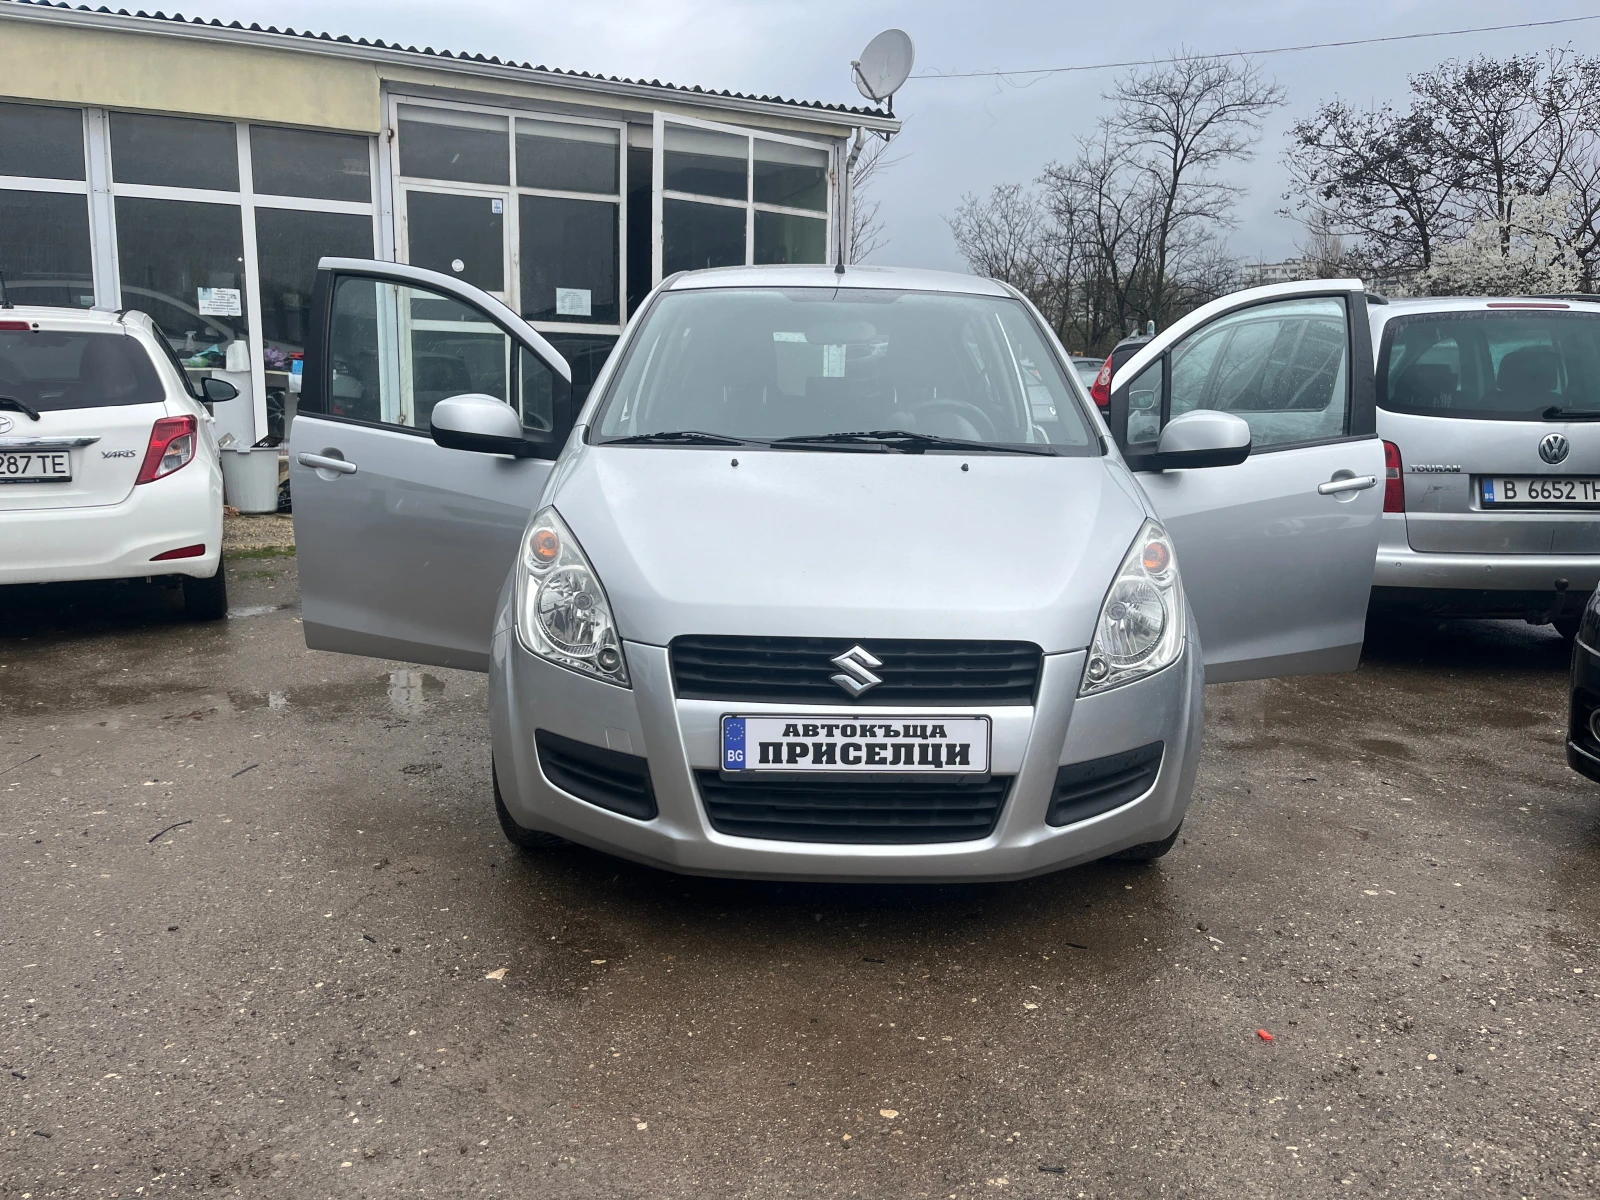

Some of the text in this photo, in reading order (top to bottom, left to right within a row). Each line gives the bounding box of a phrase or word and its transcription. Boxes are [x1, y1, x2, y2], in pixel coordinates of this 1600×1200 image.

[101, 450, 136, 459] YARIS
[37, 455, 66, 473] TE
[1409, 464, 1461, 473] TOURAN
[1503, 481, 1517, 500] B
[1528, 481, 1577, 500] 6652
[781, 723, 948, 740] АВТОКЪЩА
[727, 750, 744, 762] BG
[758, 741, 971, 768] ПРИСЕЛЦИ
